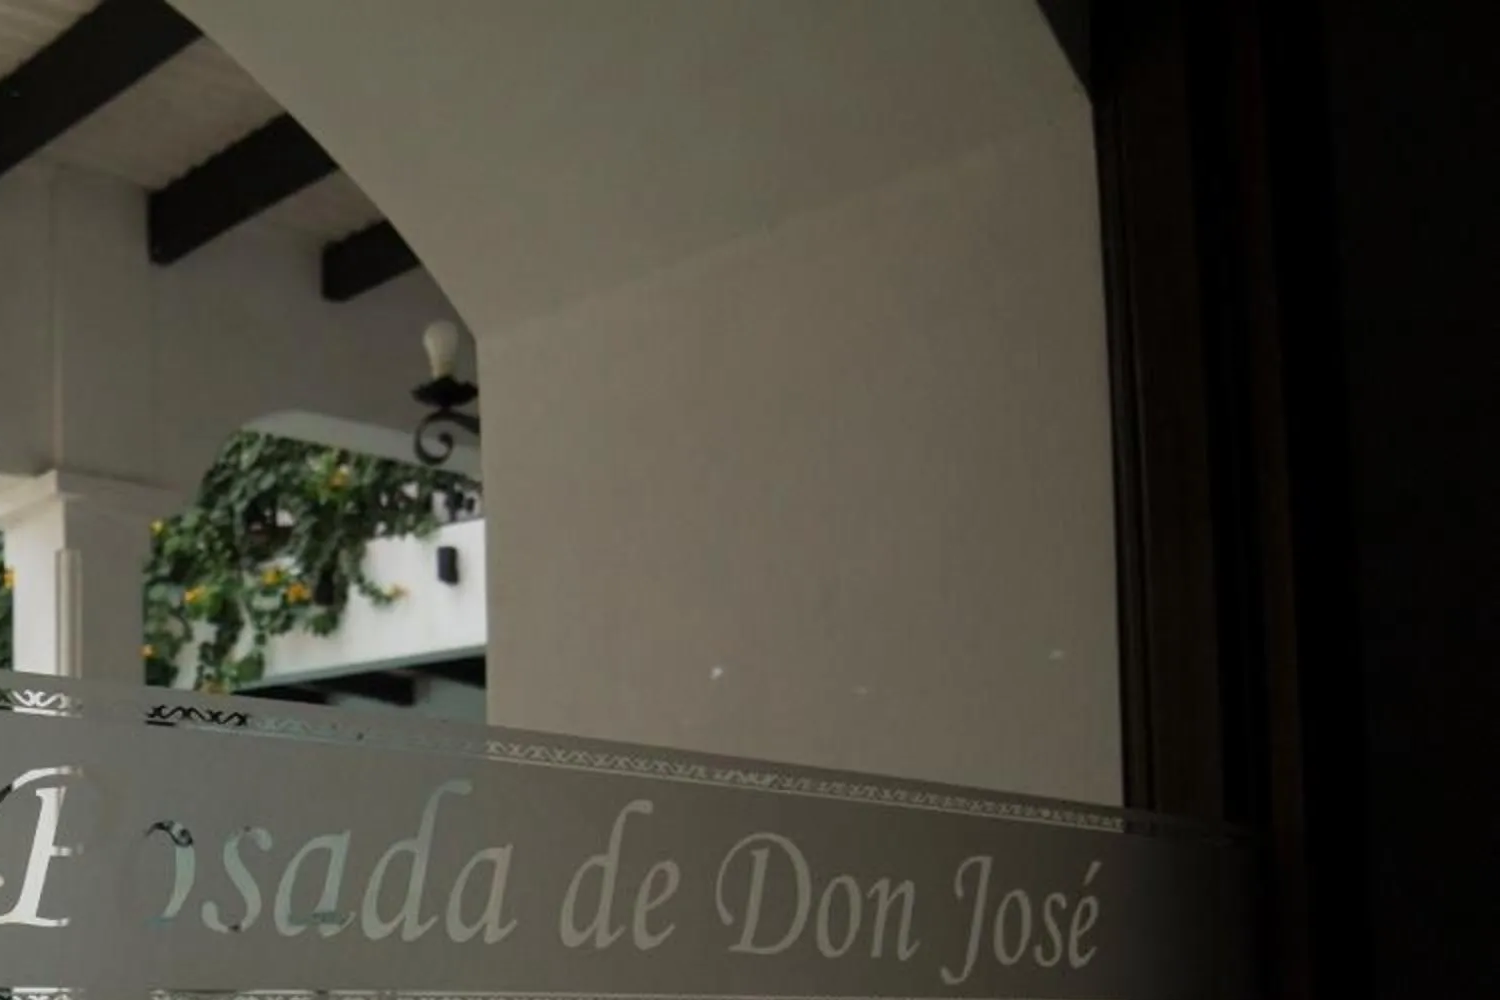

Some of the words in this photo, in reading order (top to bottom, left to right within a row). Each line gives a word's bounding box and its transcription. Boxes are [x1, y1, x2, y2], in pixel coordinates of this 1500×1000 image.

[558, 798, 680, 950] de
[714, 831, 921, 962] Don
[939, 854, 1104, 986] José
